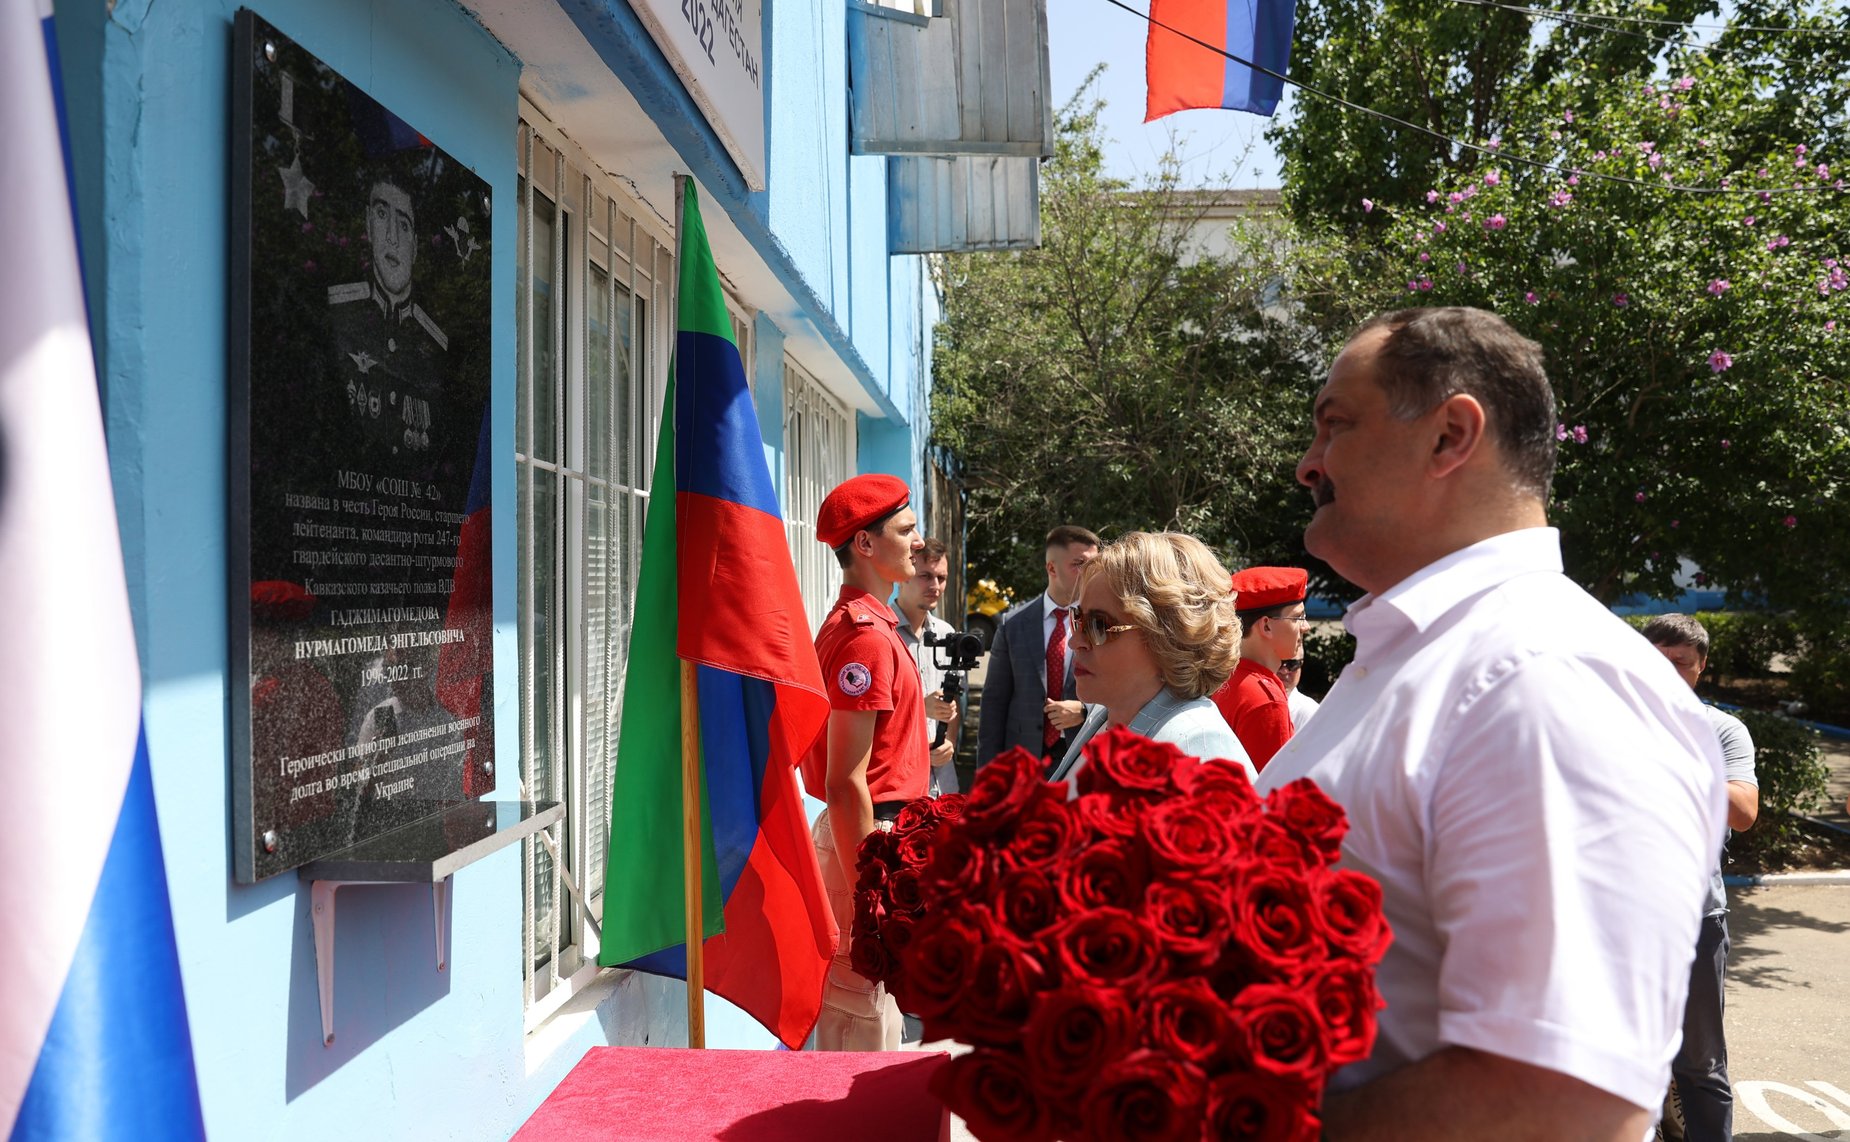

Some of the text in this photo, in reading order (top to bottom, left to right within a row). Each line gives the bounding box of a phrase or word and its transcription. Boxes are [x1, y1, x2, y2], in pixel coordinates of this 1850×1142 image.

[338, 470, 373, 491] МБОУ
[376, 476, 408, 497] «СОШ
[411, 482, 421, 498] №
[286, 493, 469, 527] названа в честь Героя России, старшего
[293, 520, 461, 548] лейтенанта, командира роты 247-го
[293, 548, 463, 570] гвардейского десантно-штурмового
[305, 578, 455, 595] Кавказского казачьего полка ВДВ
[331, 606, 439, 627] ГАДЖИМАГОМЕДОВА
[296, 629, 464, 659] НУРМАГОМЕДА ЭНГЕЛЬСОВИЧА
[361, 665, 408, 686] 1996-2022
[280, 716, 481, 777] Героически погиб при исполнении военного
[290, 738, 475, 804] долга во время специальной операции на
[375, 776, 414, 799] Украине
